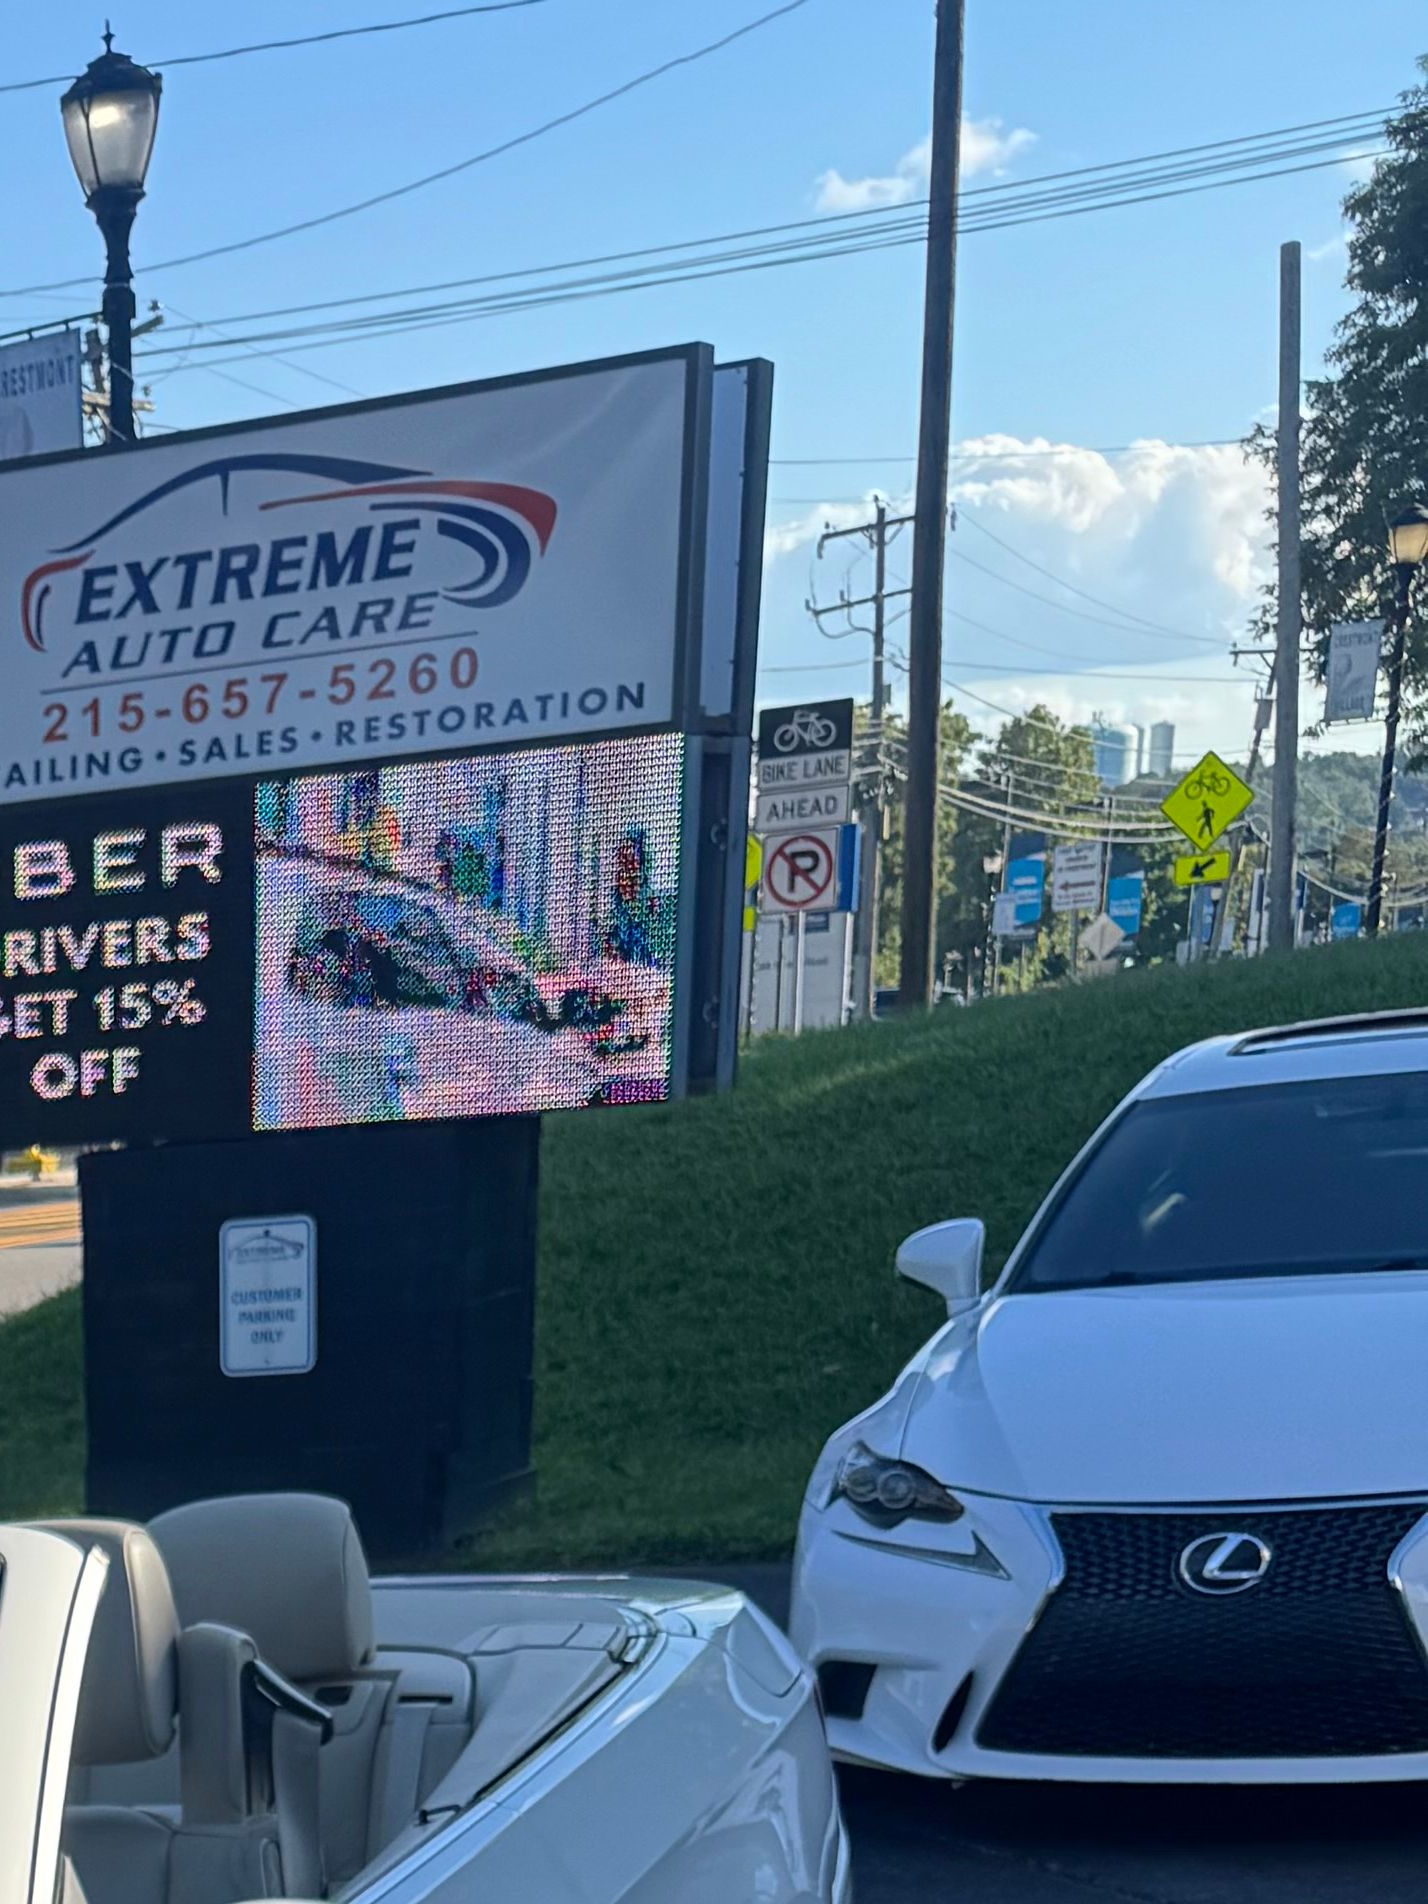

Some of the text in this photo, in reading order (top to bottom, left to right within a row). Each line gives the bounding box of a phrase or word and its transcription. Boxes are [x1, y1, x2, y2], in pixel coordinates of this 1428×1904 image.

[73, 518, 421, 625] EXTREME
[60, 590, 441, 678] AUTO CARE
[42, 646, 479, 744] 215-657-5260
[178, 726, 298, 767] SALES
[334, 682, 645, 747] RESTORATION
[761, 755, 845, 784] BIKE LANE
[765, 796, 838, 822] AHEAD
[93, 978, 207, 1032] 15%
[29, 1046, 143, 1101] OFF
[231, 1287, 302, 1306] CUSTOMER
[238, 1308, 296, 1325] PARKING
[250, 1330, 284, 1345] ONLY
